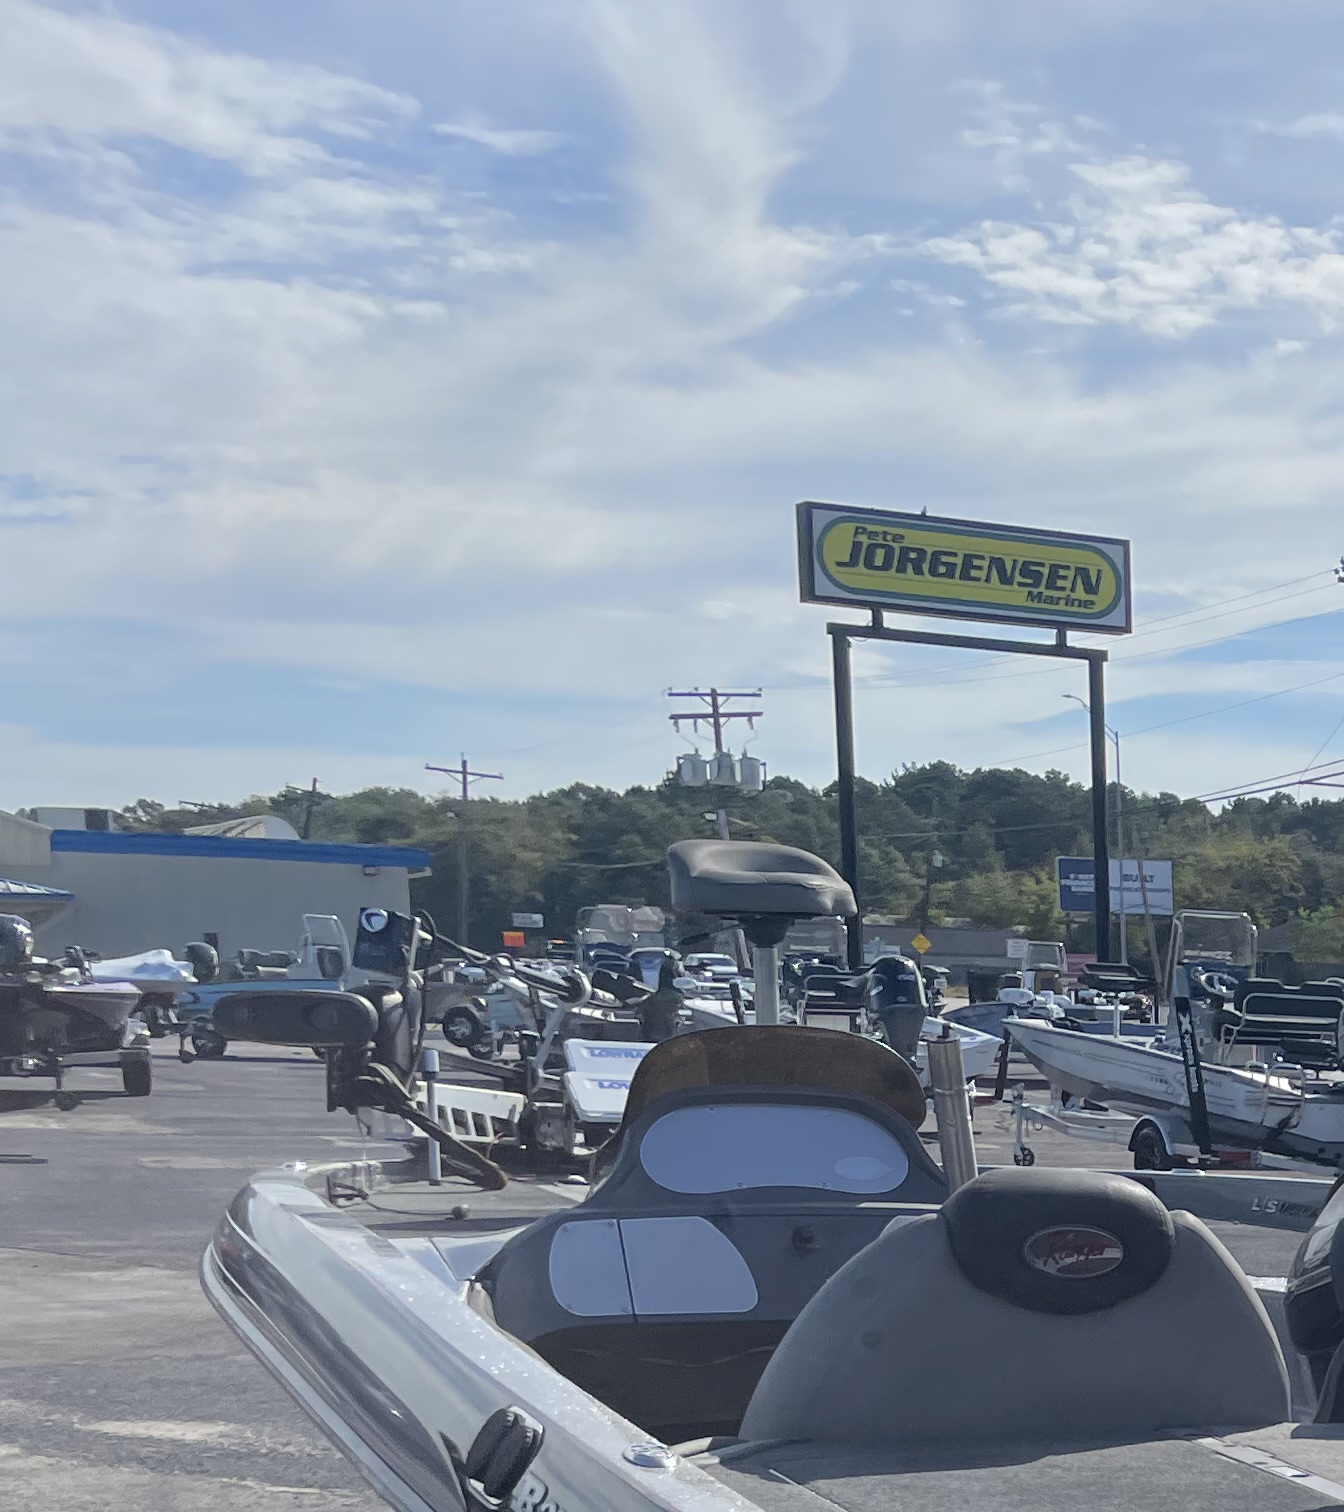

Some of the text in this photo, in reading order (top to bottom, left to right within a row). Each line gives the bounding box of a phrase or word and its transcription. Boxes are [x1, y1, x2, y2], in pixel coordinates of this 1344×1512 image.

[853, 525, 905, 544] Pete
[835, 540, 1103, 596] JORGENSEN
[1025, 590, 1096, 610] Marine
